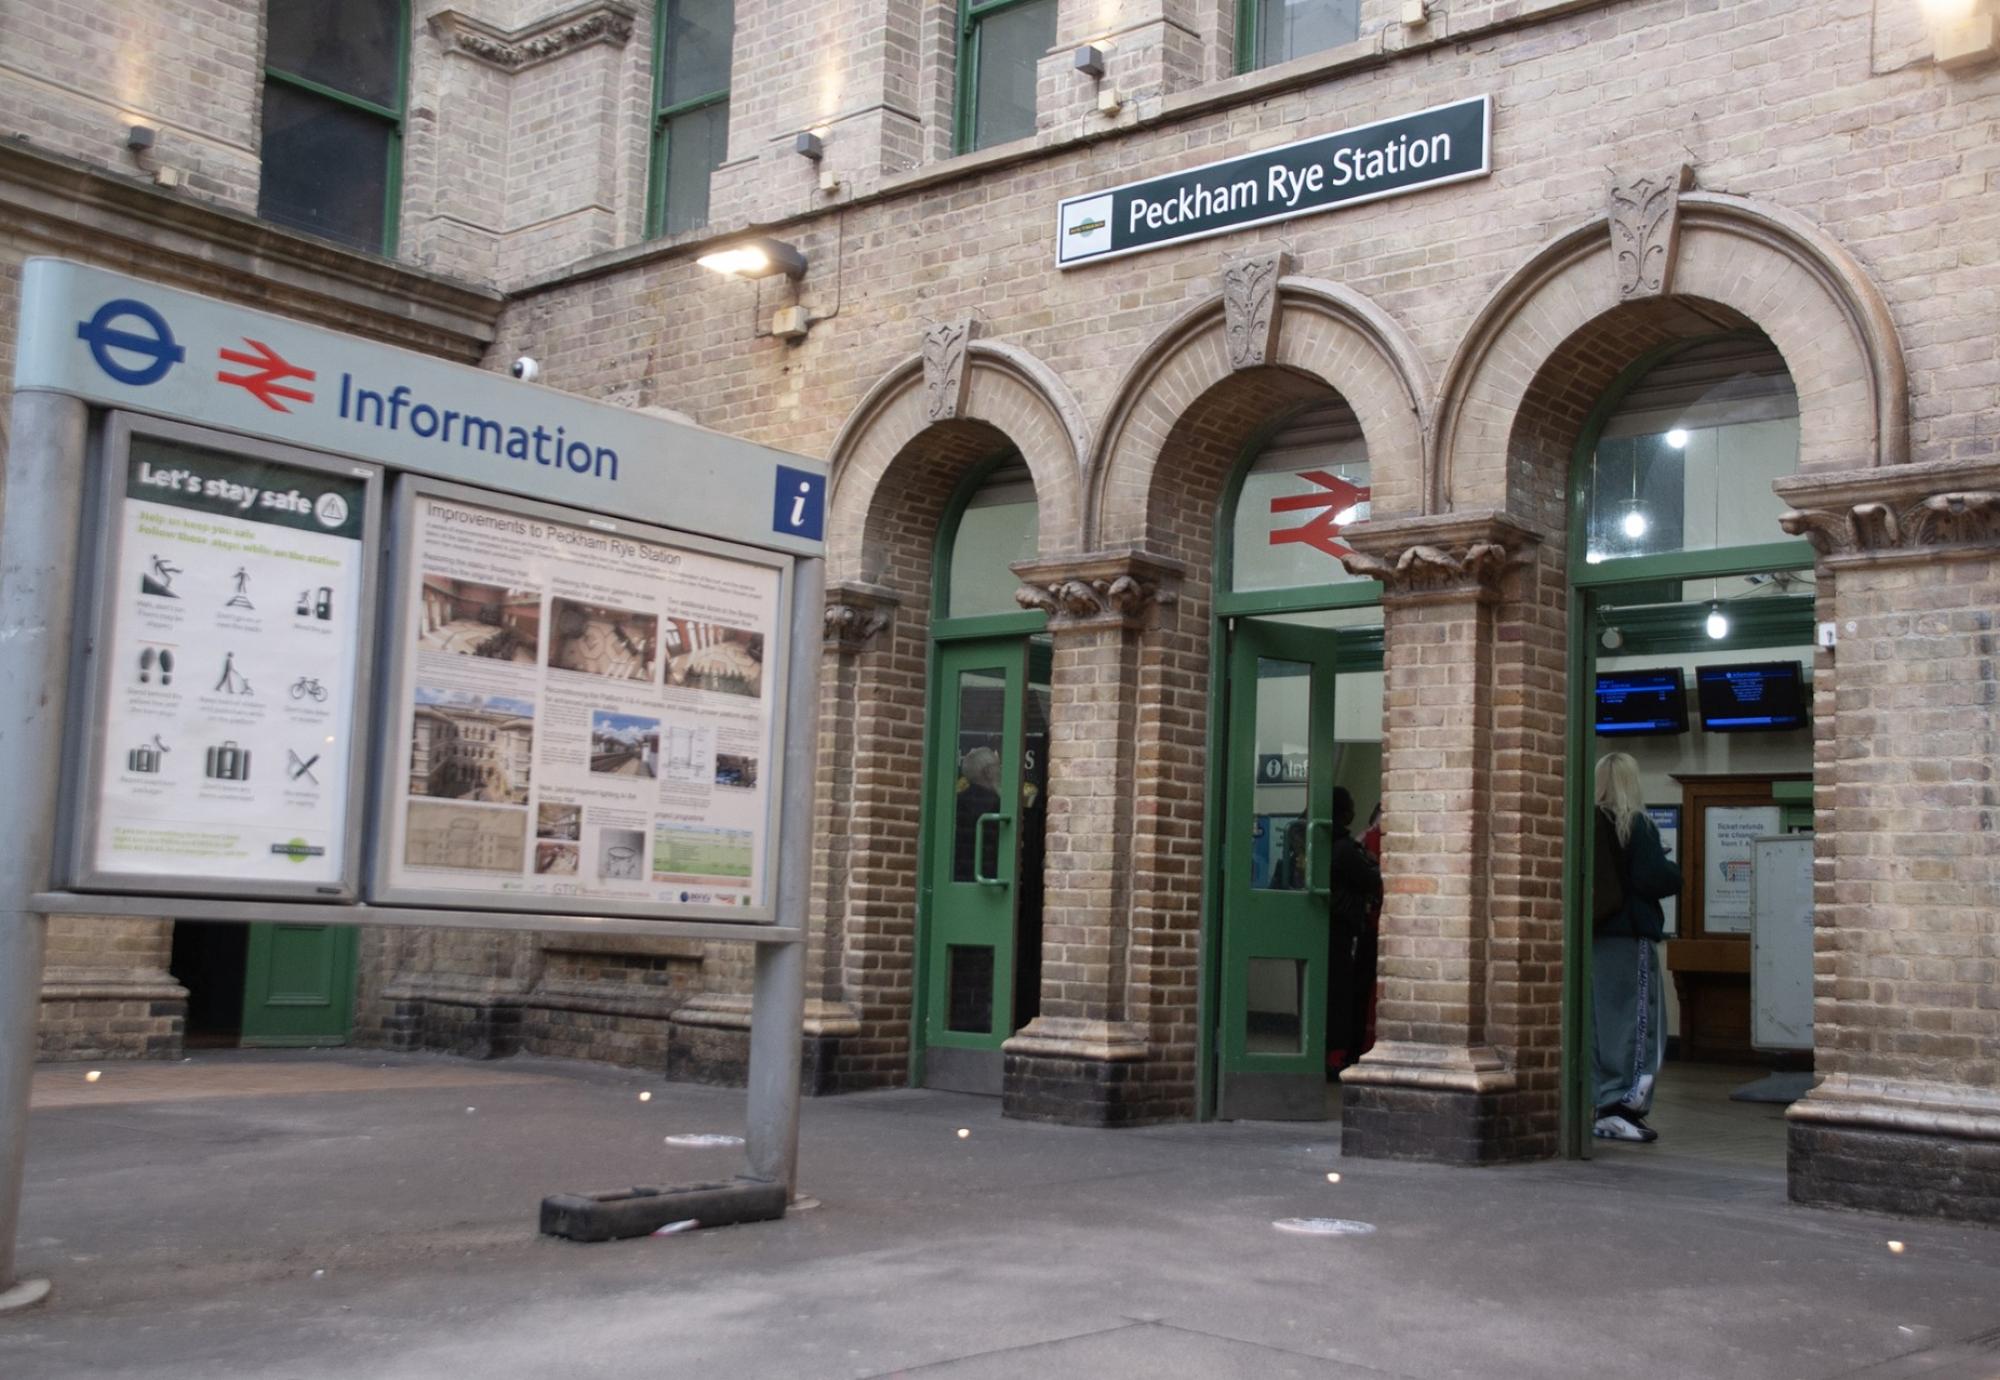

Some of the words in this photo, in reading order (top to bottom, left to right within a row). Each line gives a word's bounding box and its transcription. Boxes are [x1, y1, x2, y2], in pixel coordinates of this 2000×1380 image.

[1129, 179, 1258, 234] Peckham
[1267, 164, 1324, 207] Rye
[1332, 132, 1450, 186] Station
[339, 373, 620, 482] Information
[140, 462, 201, 492] Let's
[204, 478, 258, 508] stay
[262, 490, 312, 513] safe
[427, 502, 527, 535] Improvements
[530, 524, 543, 539] to
[546, 526, 608, 551] Peckham
[611, 540, 636, 559] Rye
[639, 545, 682, 566] Station
